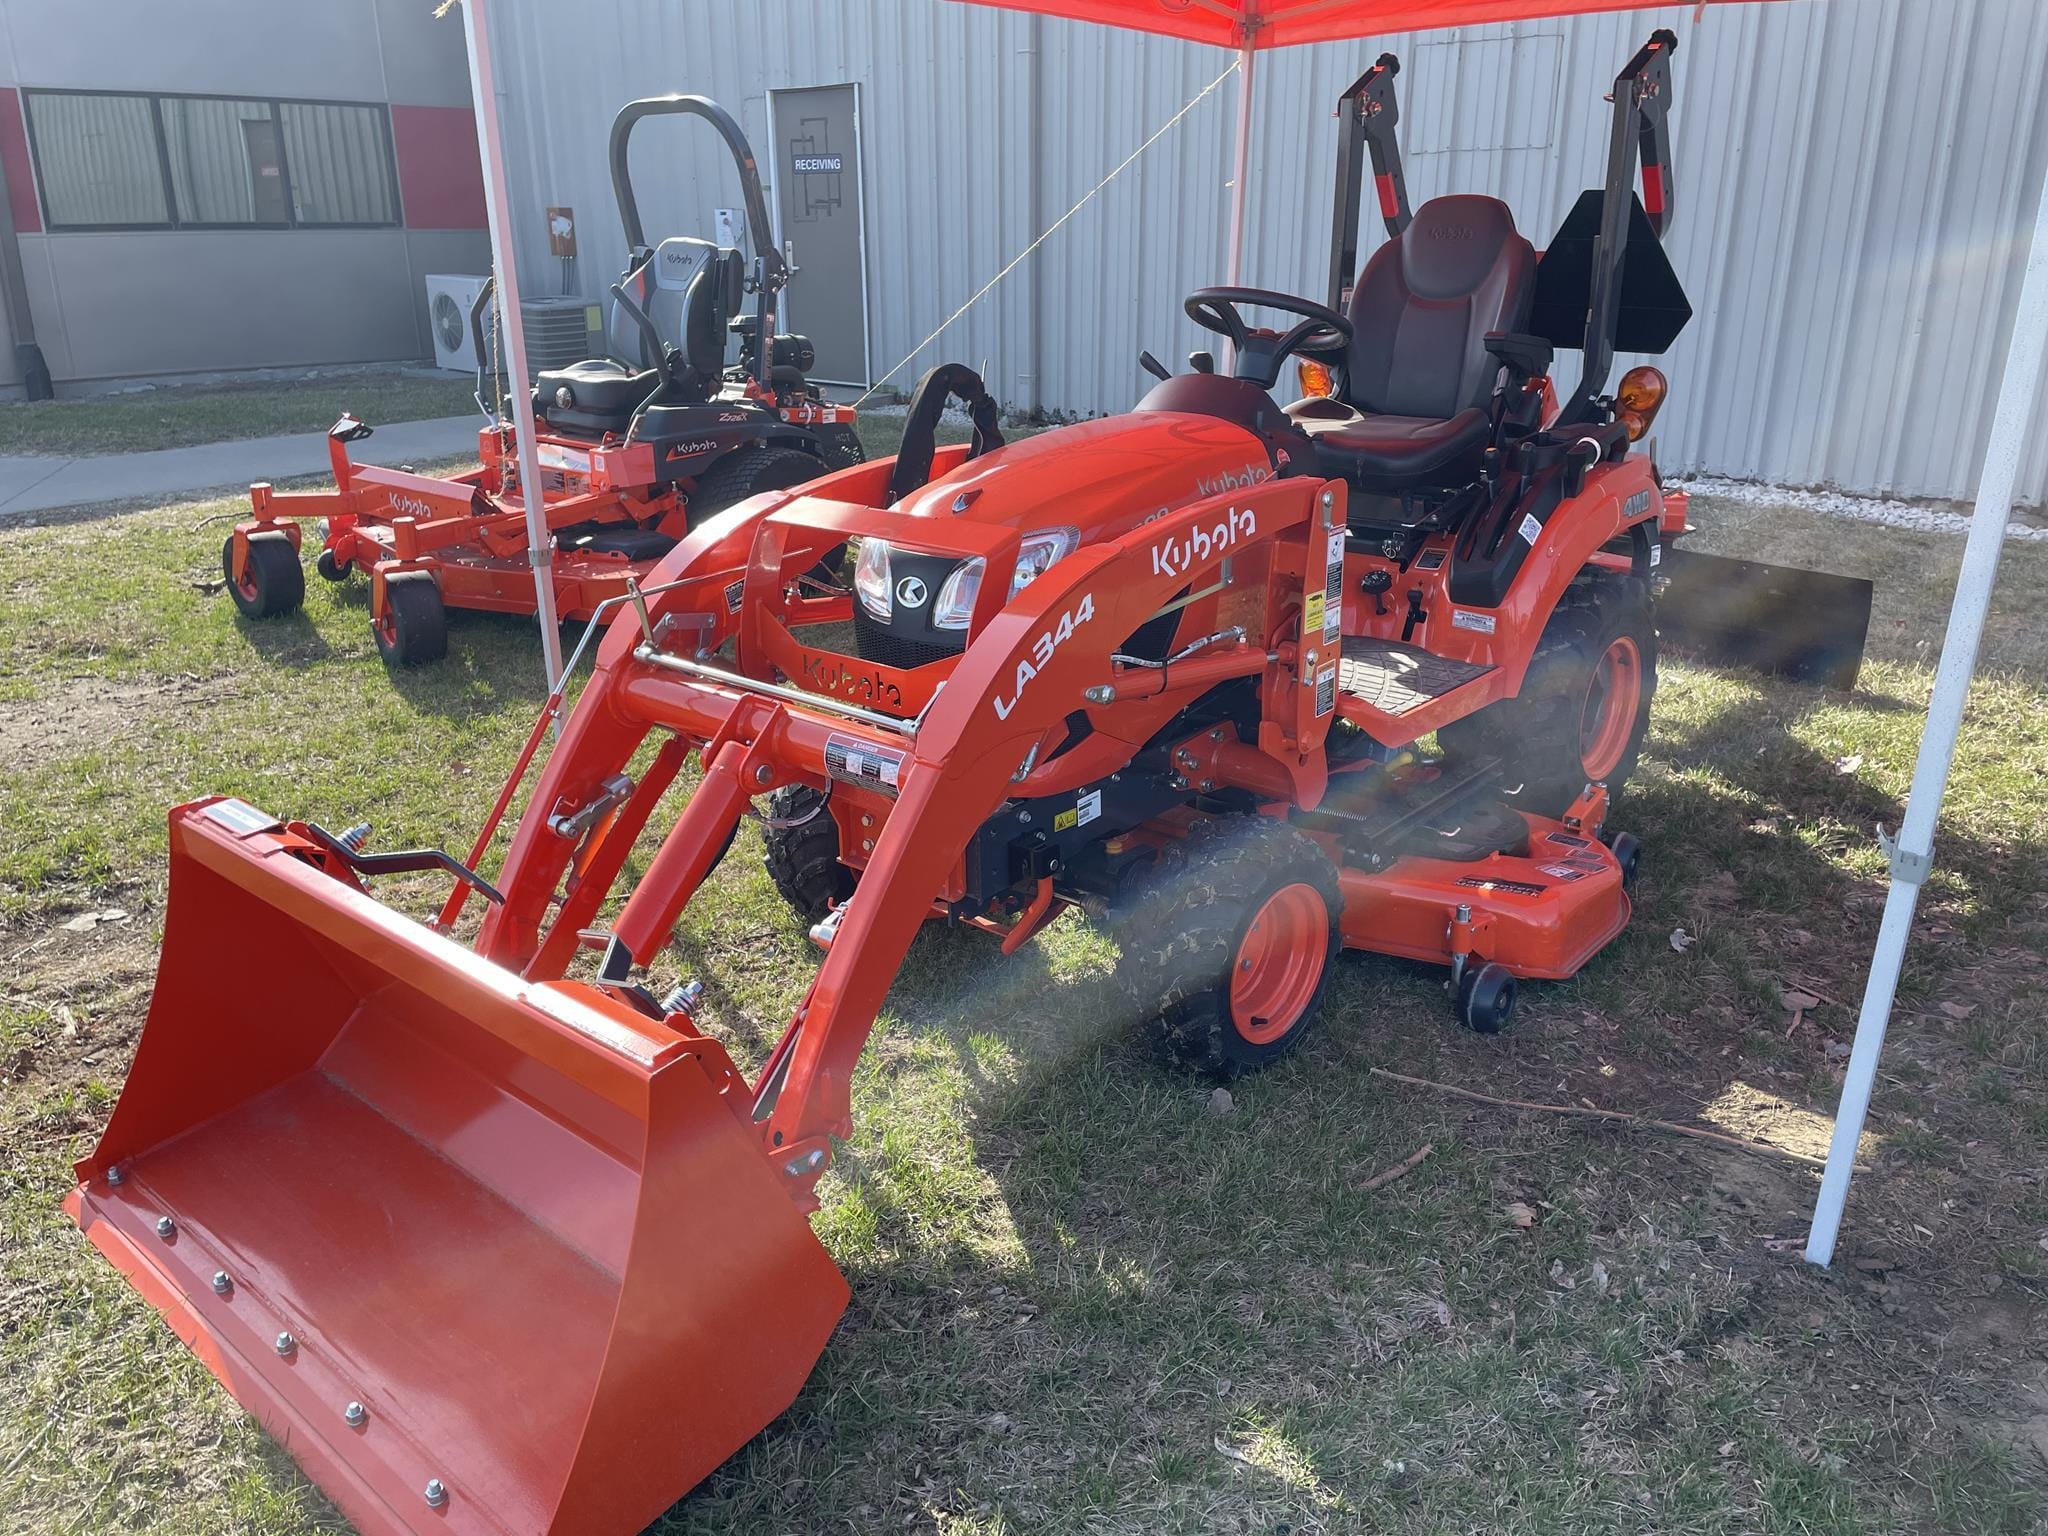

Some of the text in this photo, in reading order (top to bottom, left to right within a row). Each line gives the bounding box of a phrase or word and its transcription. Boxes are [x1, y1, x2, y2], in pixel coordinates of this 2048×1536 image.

[795, 158, 841, 171] RECEIVING
[666, 253, 693, 265] Kubota
[677, 440, 717, 454] Kubota
[1197, 463, 1267, 496] Kubota
[388, 492, 432, 518] Kubota
[1623, 489, 1649, 517] 4WD
[1152, 506, 1256, 578] Kubota
[993, 592, 1095, 721] LA344
[803, 654, 902, 708] Kubota
